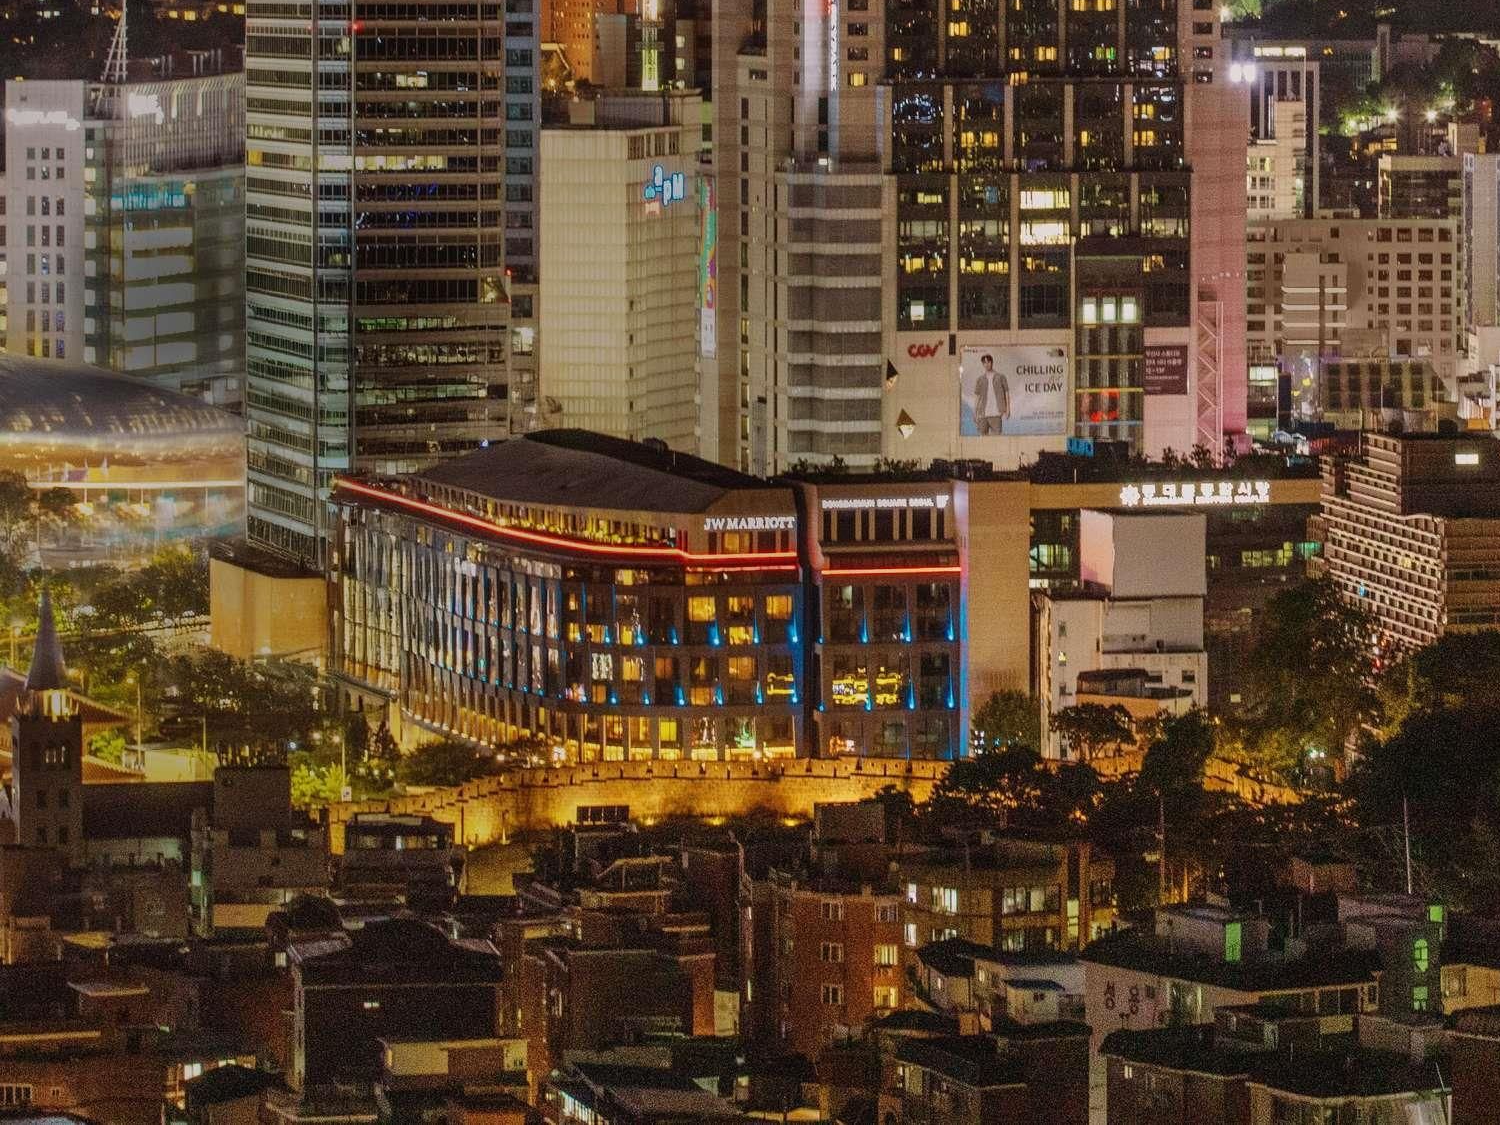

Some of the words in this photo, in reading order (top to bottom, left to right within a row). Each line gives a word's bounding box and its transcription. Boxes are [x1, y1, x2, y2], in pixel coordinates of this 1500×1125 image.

[907, 342, 941, 358] CGV
[1016, 364, 1064, 375] CHILLING
[1024, 383, 1040, 393] ICE
[1043, 382, 1064, 393] DAY
[704, 517, 724, 531] JW
[727, 516, 796, 530] MARRIOTT
